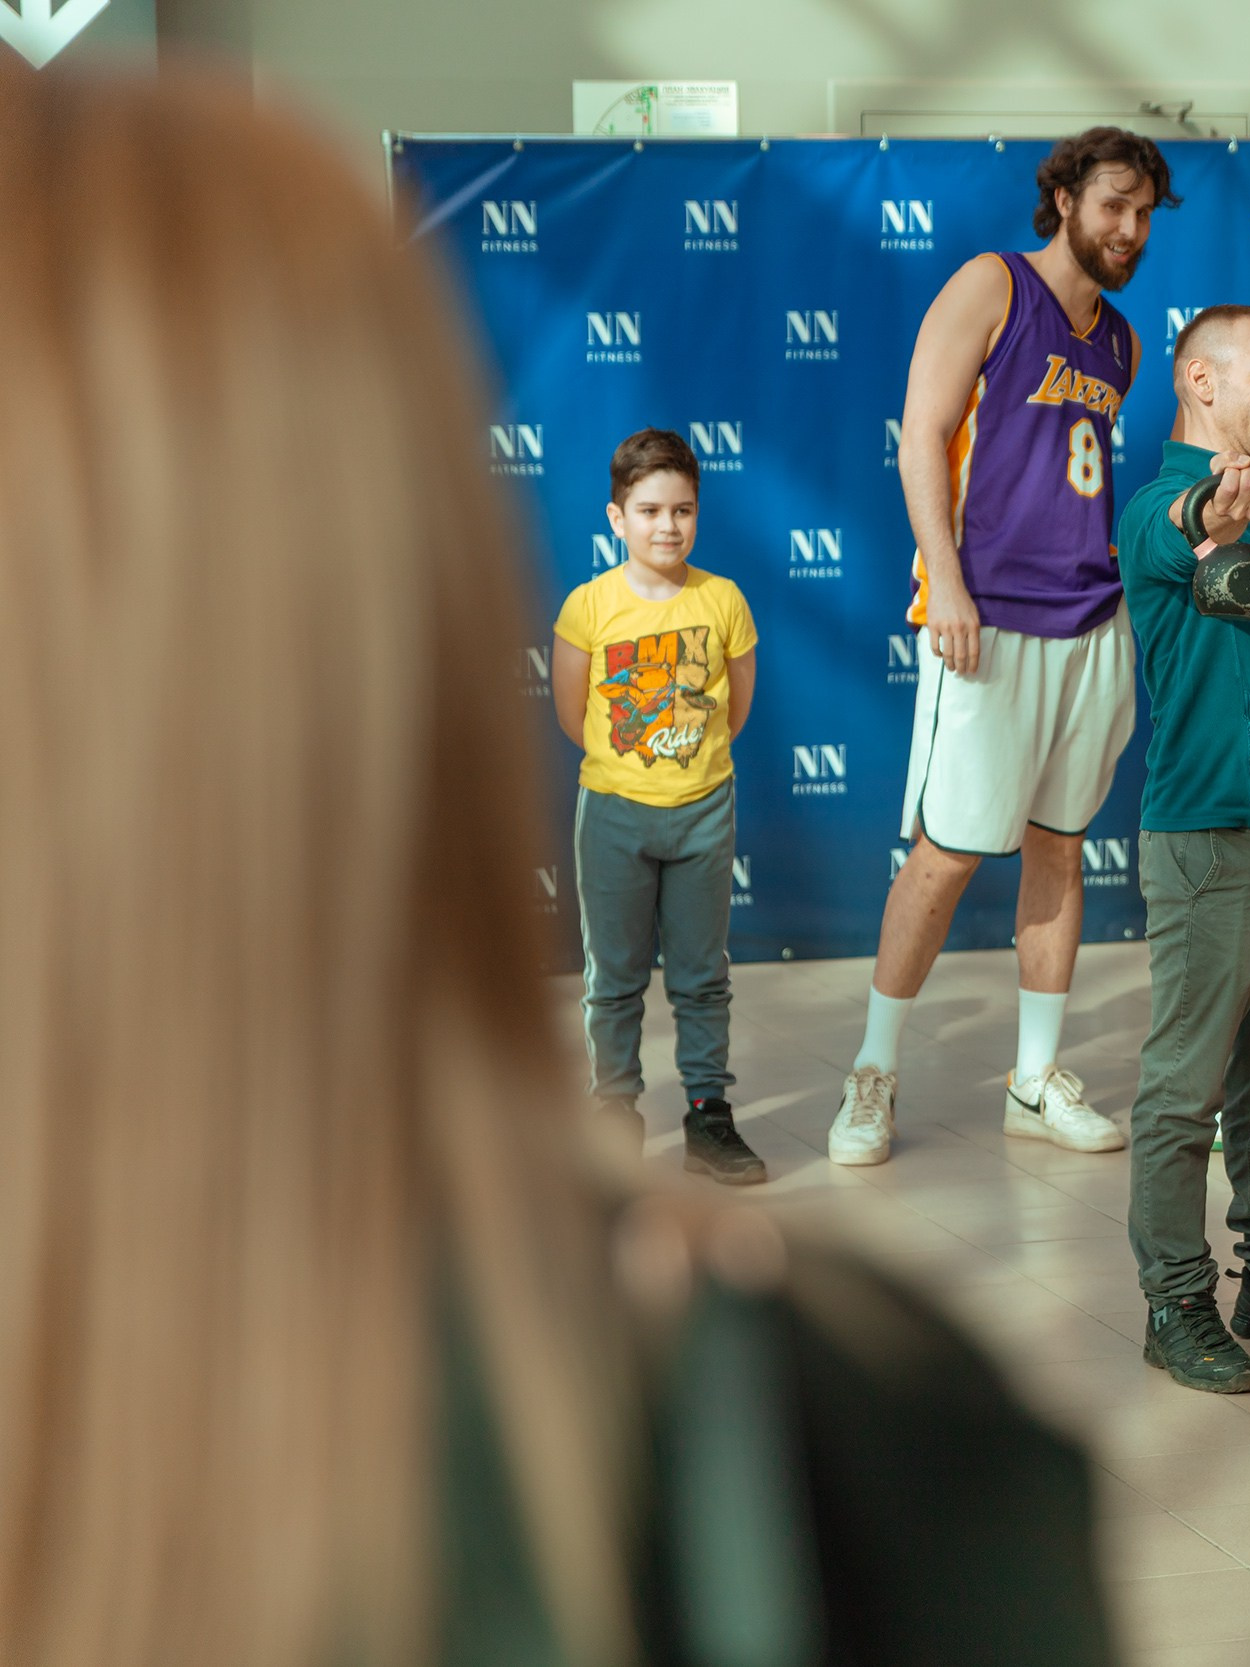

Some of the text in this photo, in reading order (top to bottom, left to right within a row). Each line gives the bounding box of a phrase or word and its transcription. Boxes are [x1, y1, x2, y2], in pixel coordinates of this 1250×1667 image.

[482, 200, 537, 236] NN
[685, 200, 739, 234] NN
[881, 200, 934, 234] NN
[481, 240, 538, 252] FITNESS
[684, 239, 739, 251] FITNESS
[880, 239, 934, 251] FITNESS
[587, 311, 641, 346] NN
[786, 310, 838, 344] NN
[586, 350, 642, 363] FITNESS
[785, 348, 839, 361] FITNESS
[490, 424, 543, 459] NN
[689, 422, 742, 454] NN
[702, 459, 744, 471] TNESS
[1067, 417, 1104, 498] 8
[790, 529, 842, 562] NN
[789, 567, 843, 579] FITNESS
[605, 626, 709, 680] BMX
[887, 671, 919, 684] FITN
[793, 744, 847, 779] NN
[792, 783, 848, 795] FITNESS
[1081, 837, 1129, 870] NN
[1083, 873, 1129, 886] ITNESS
